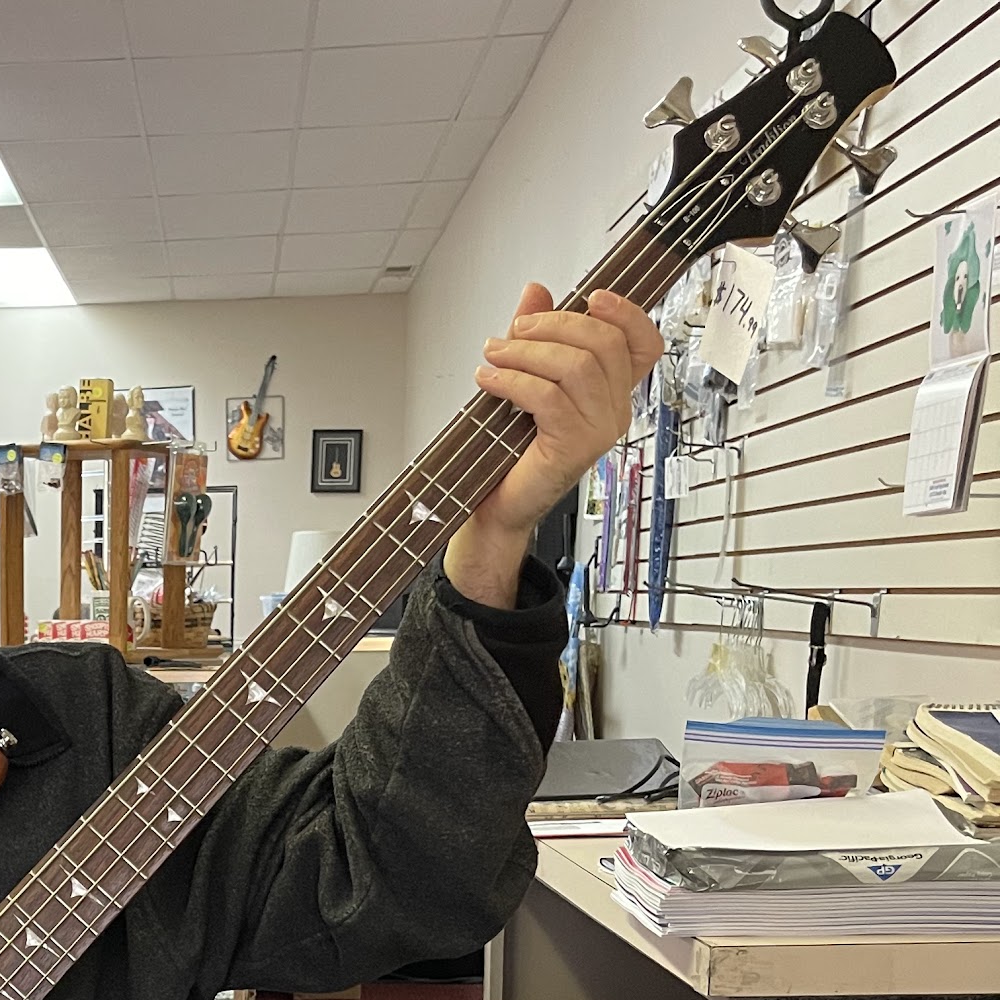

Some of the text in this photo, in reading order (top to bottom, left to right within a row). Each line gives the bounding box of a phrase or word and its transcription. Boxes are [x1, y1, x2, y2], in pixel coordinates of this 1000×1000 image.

[713, 281, 758, 339] $174.99
[706, 787, 739, 800] Ziploc
[876, 866, 896, 876] GP
